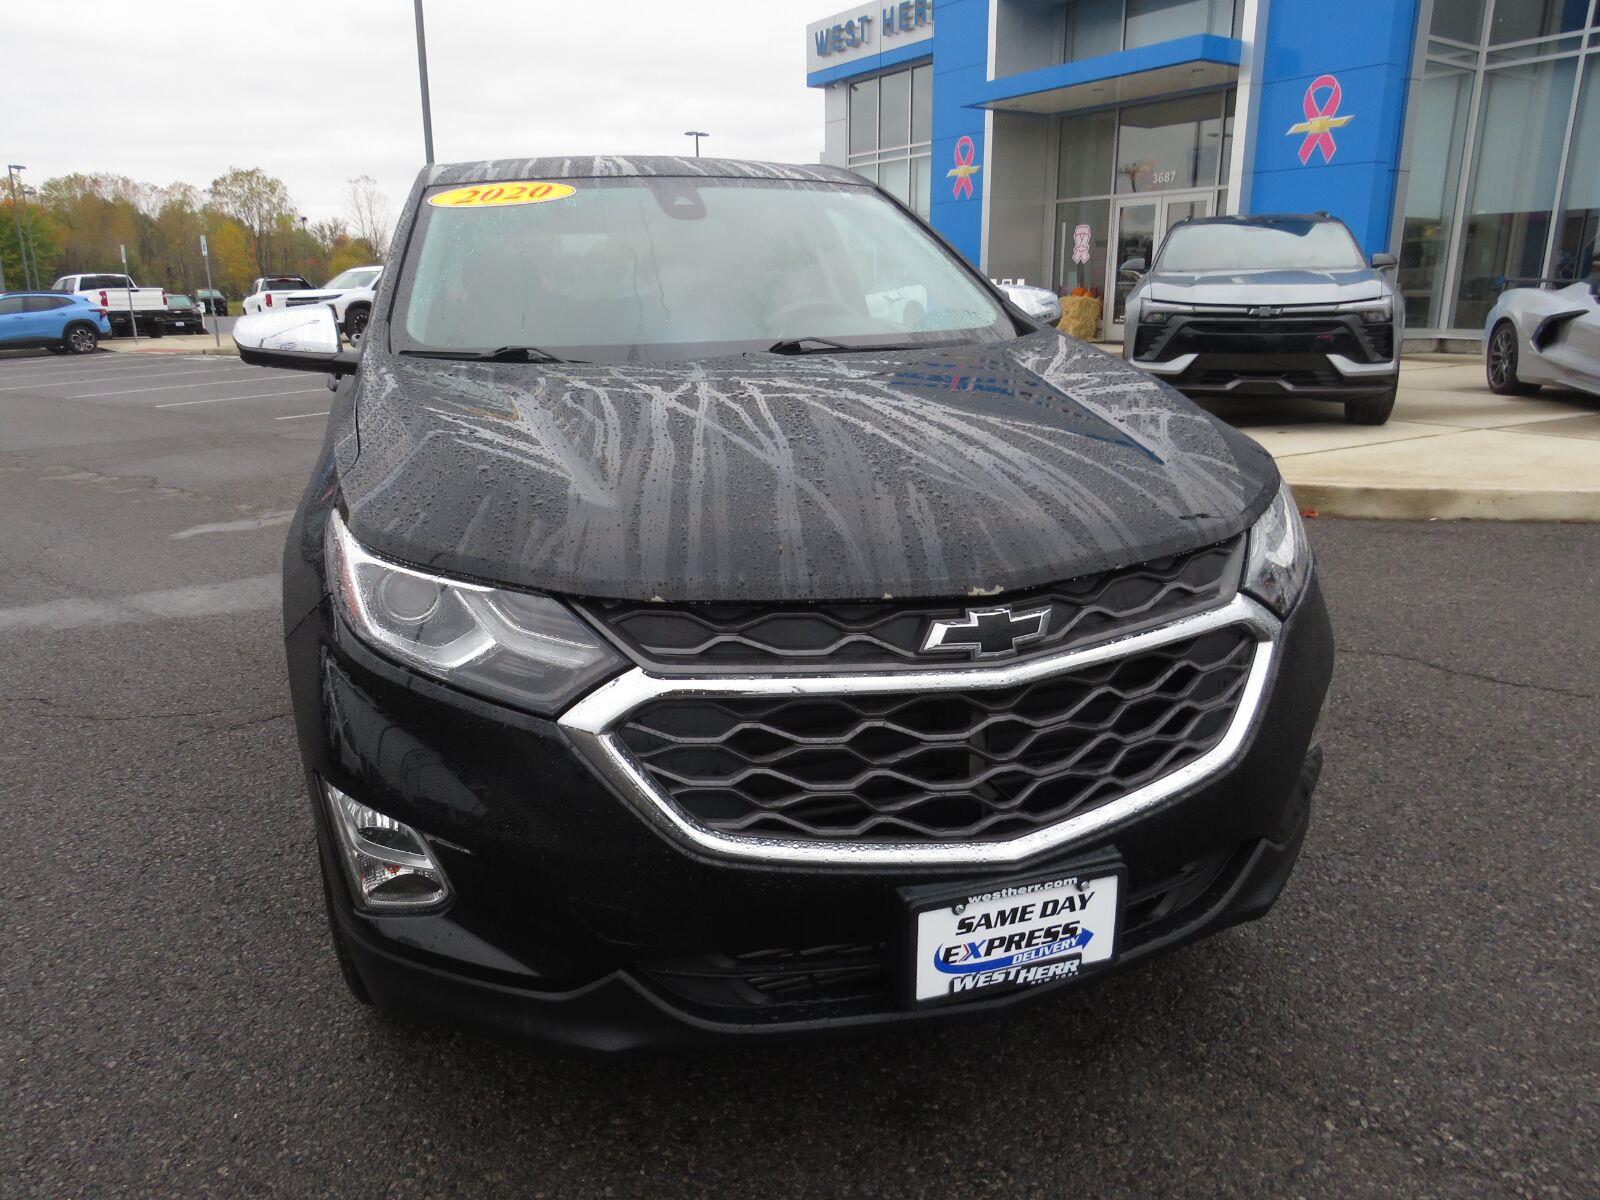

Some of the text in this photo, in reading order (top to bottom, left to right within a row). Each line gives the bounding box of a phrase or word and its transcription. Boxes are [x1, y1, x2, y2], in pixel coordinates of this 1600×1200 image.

[814, 0, 933, 57] WEST HER
[1152, 170, 1177, 184] 3687
[453, 184, 553, 205] 2020
[967, 876, 1079, 904] westherr.com
[955, 891, 1095, 936] SAME DAY
[942, 920, 1081, 964] EXPRESS
[1011, 935, 1079, 965] DELIVERY
